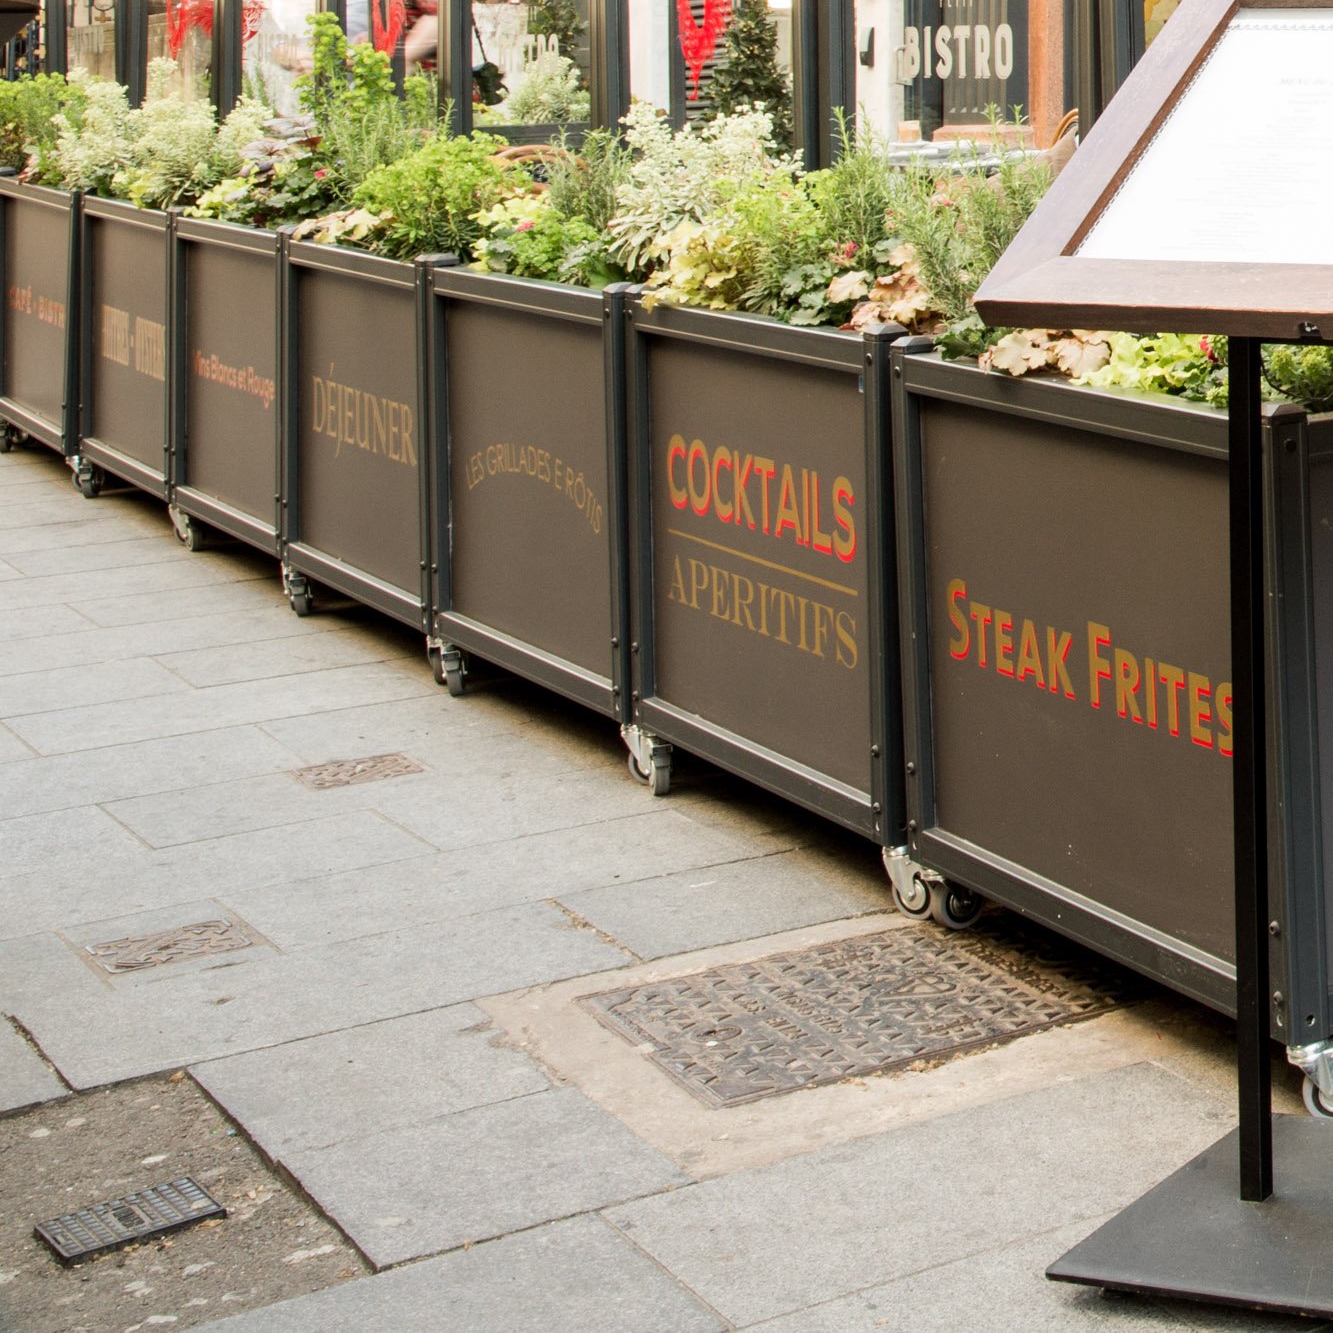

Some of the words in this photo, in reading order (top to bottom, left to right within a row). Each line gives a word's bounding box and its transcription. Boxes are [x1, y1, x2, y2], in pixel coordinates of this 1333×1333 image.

[905, 24, 1013, 80] BISTRO
[9, 286, 32, 314] CAFÉ
[39, 296, 65, 330] BISTR
[211, 354, 237, 389] Blancs
[238, 368, 247, 390] et
[313, 362, 417, 467] DÉJEUNER
[466, 451, 484, 491] LES
[487, 443, 550, 484] GRILLADES
[565, 467, 602, 534] RÔTIS
[667, 433, 857, 563] COCKTAILS
[667, 553, 858, 669] APERITIFS
[947, 578, 1076, 701] STEAK
[1087, 621, 1233, 757] FRITES
